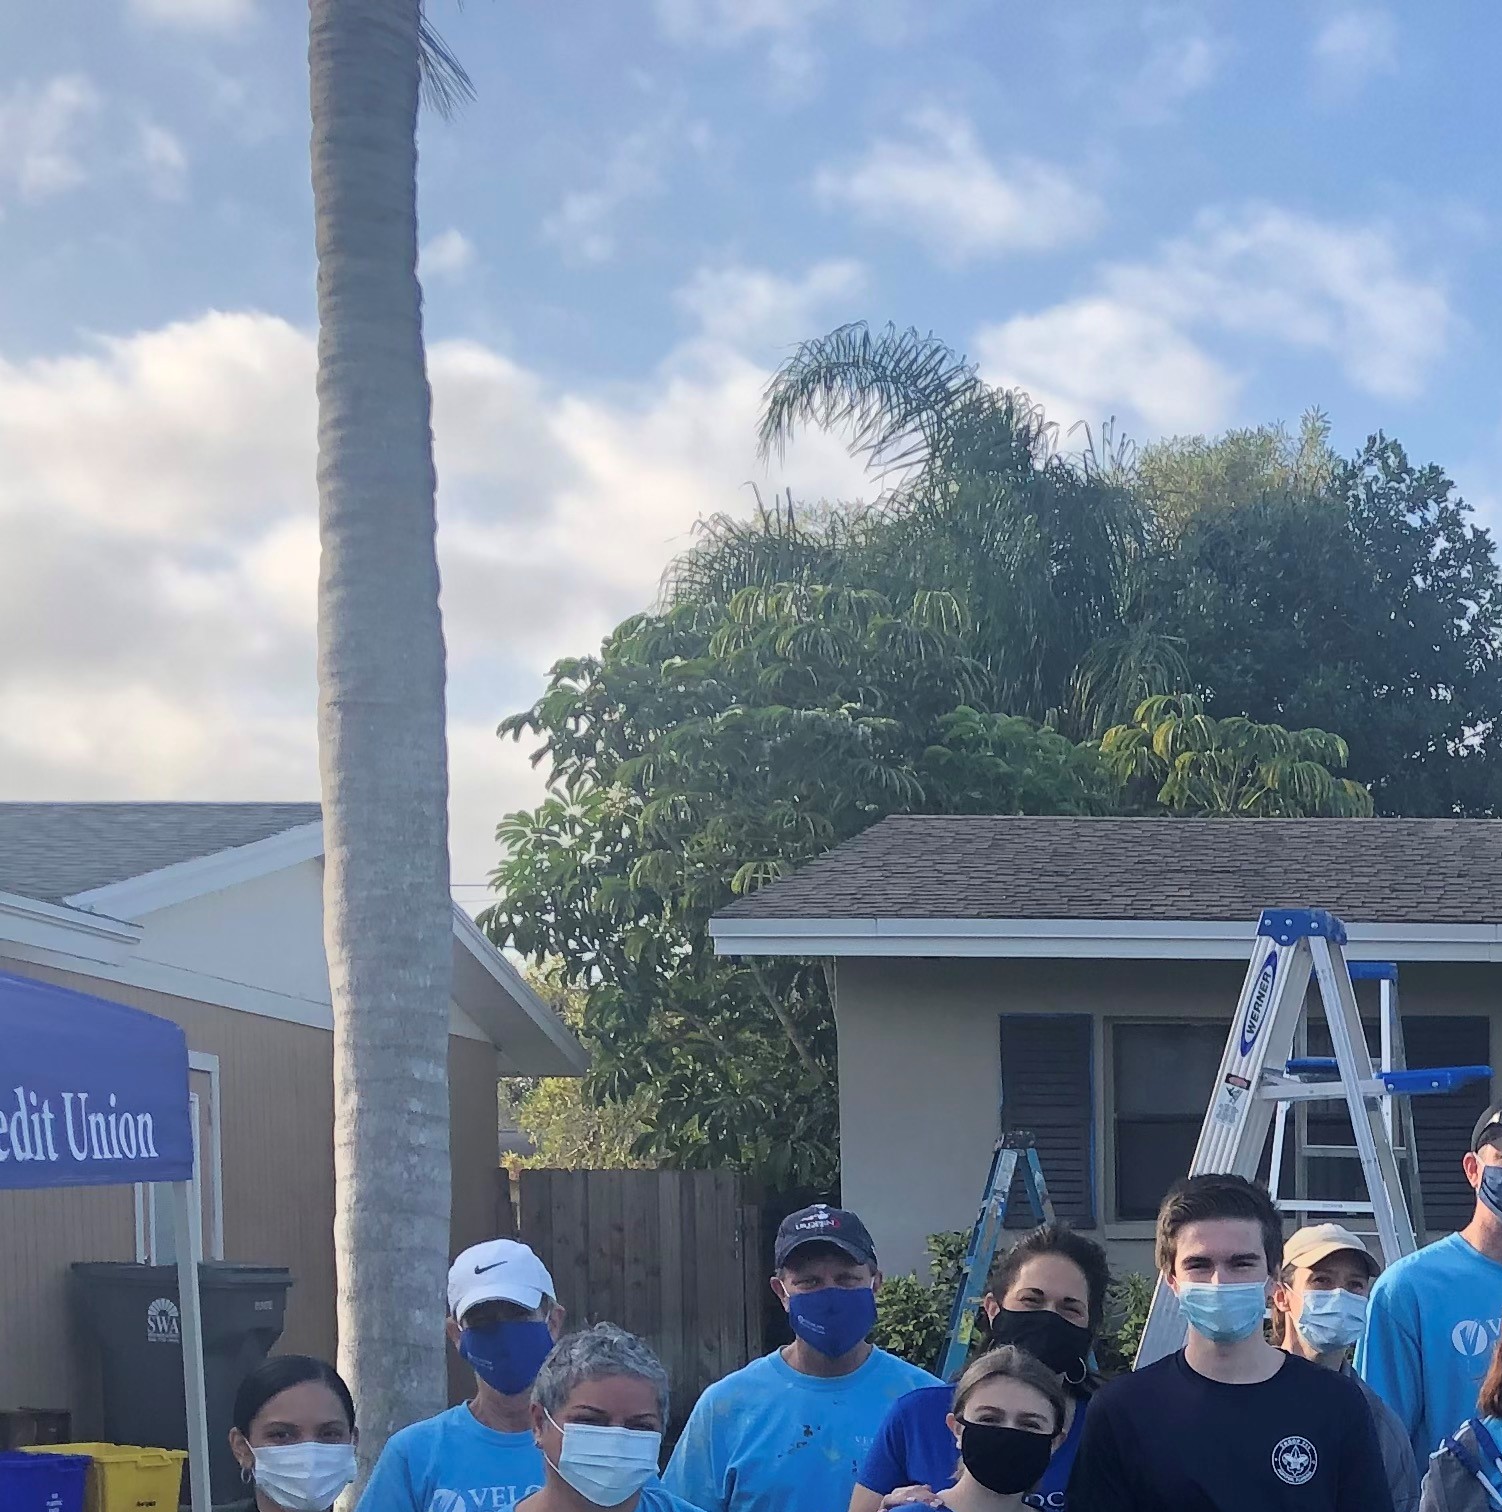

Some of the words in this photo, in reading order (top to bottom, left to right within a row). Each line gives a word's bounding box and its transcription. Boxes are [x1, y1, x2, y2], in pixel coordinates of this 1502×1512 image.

[1246, 971, 1272, 1035] WERNER
[61, 1092, 159, 1161] Union
[147, 1315, 179, 1334] SWA
